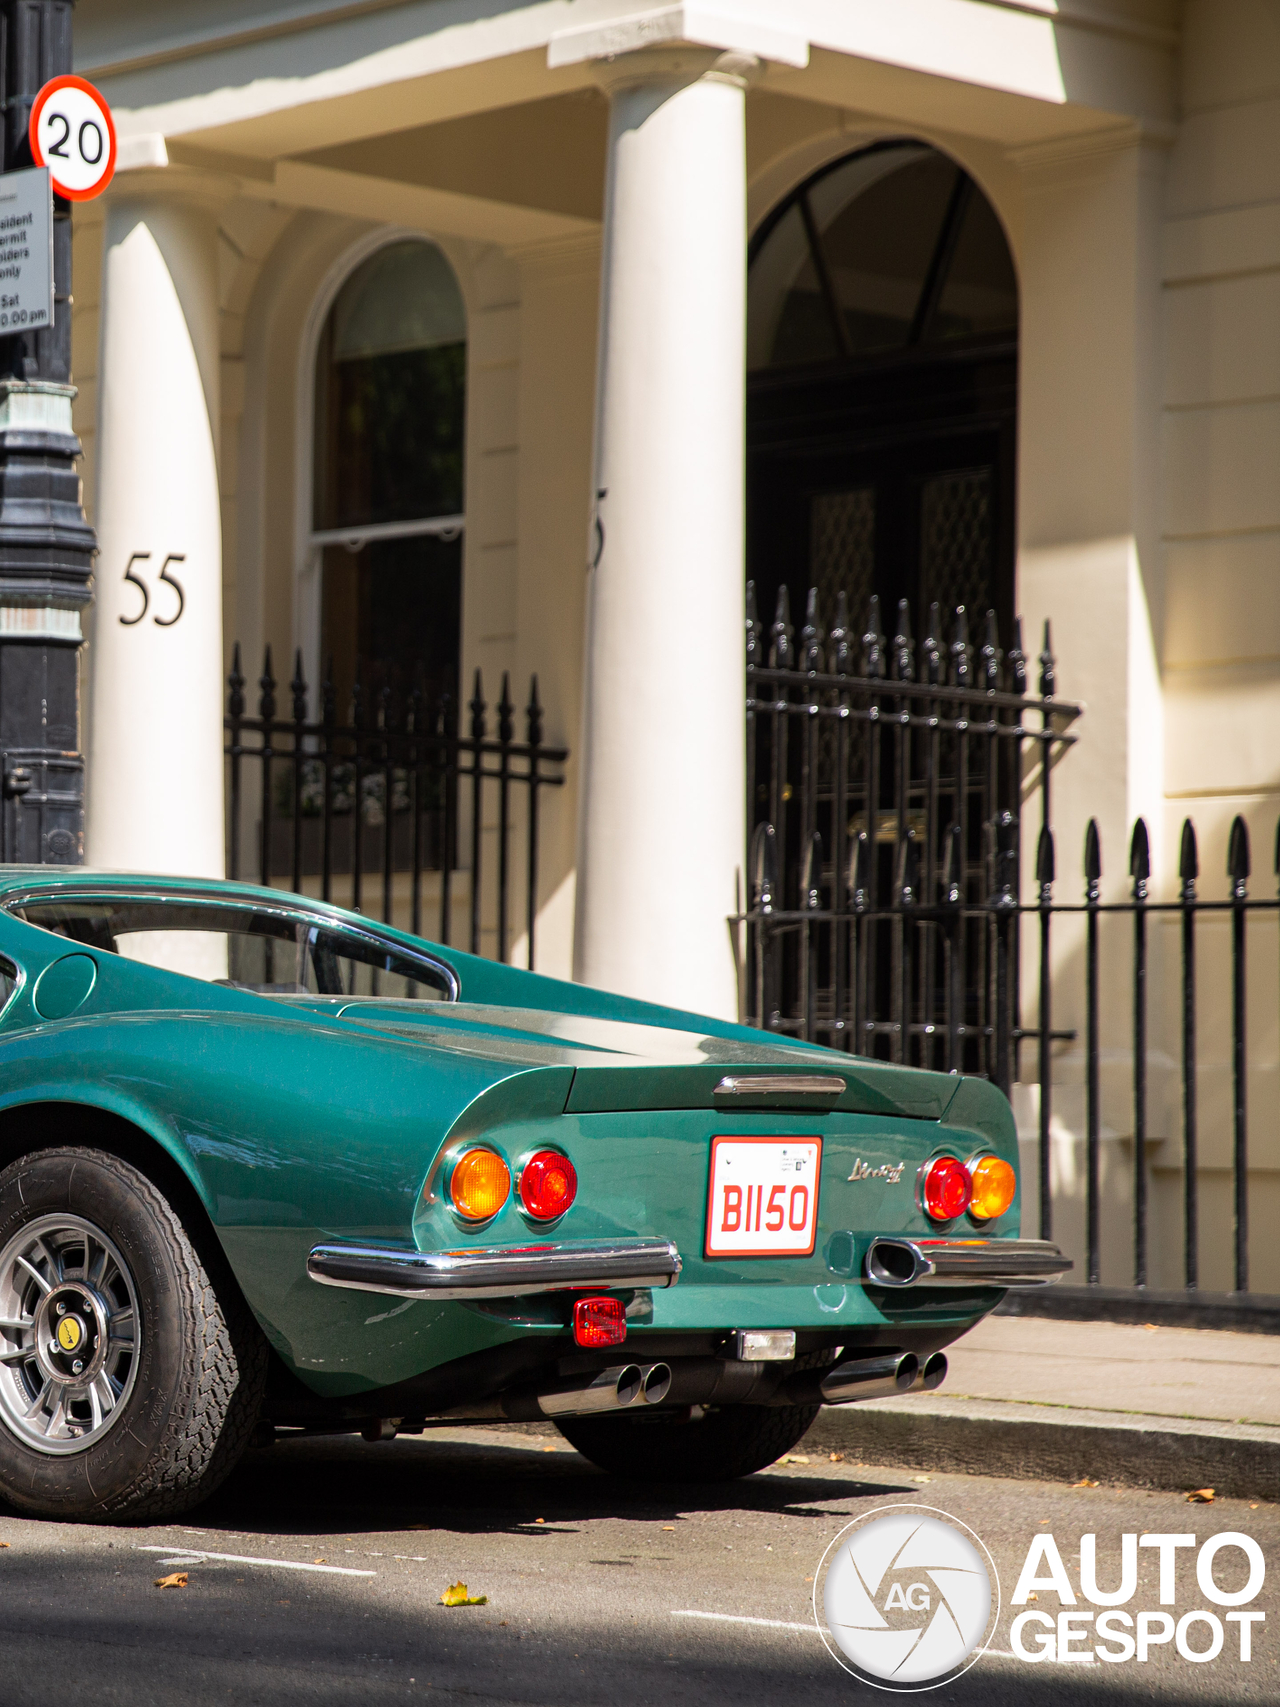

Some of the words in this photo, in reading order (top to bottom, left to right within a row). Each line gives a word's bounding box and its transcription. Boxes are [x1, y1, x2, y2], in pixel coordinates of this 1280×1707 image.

[47, 113, 103, 165] 20
[0, 293, 19, 310] Sat
[29, 309, 47, 323] pm
[118, 551, 186, 627] 55
[132, 1210, 170, 1293] MICHELIN
